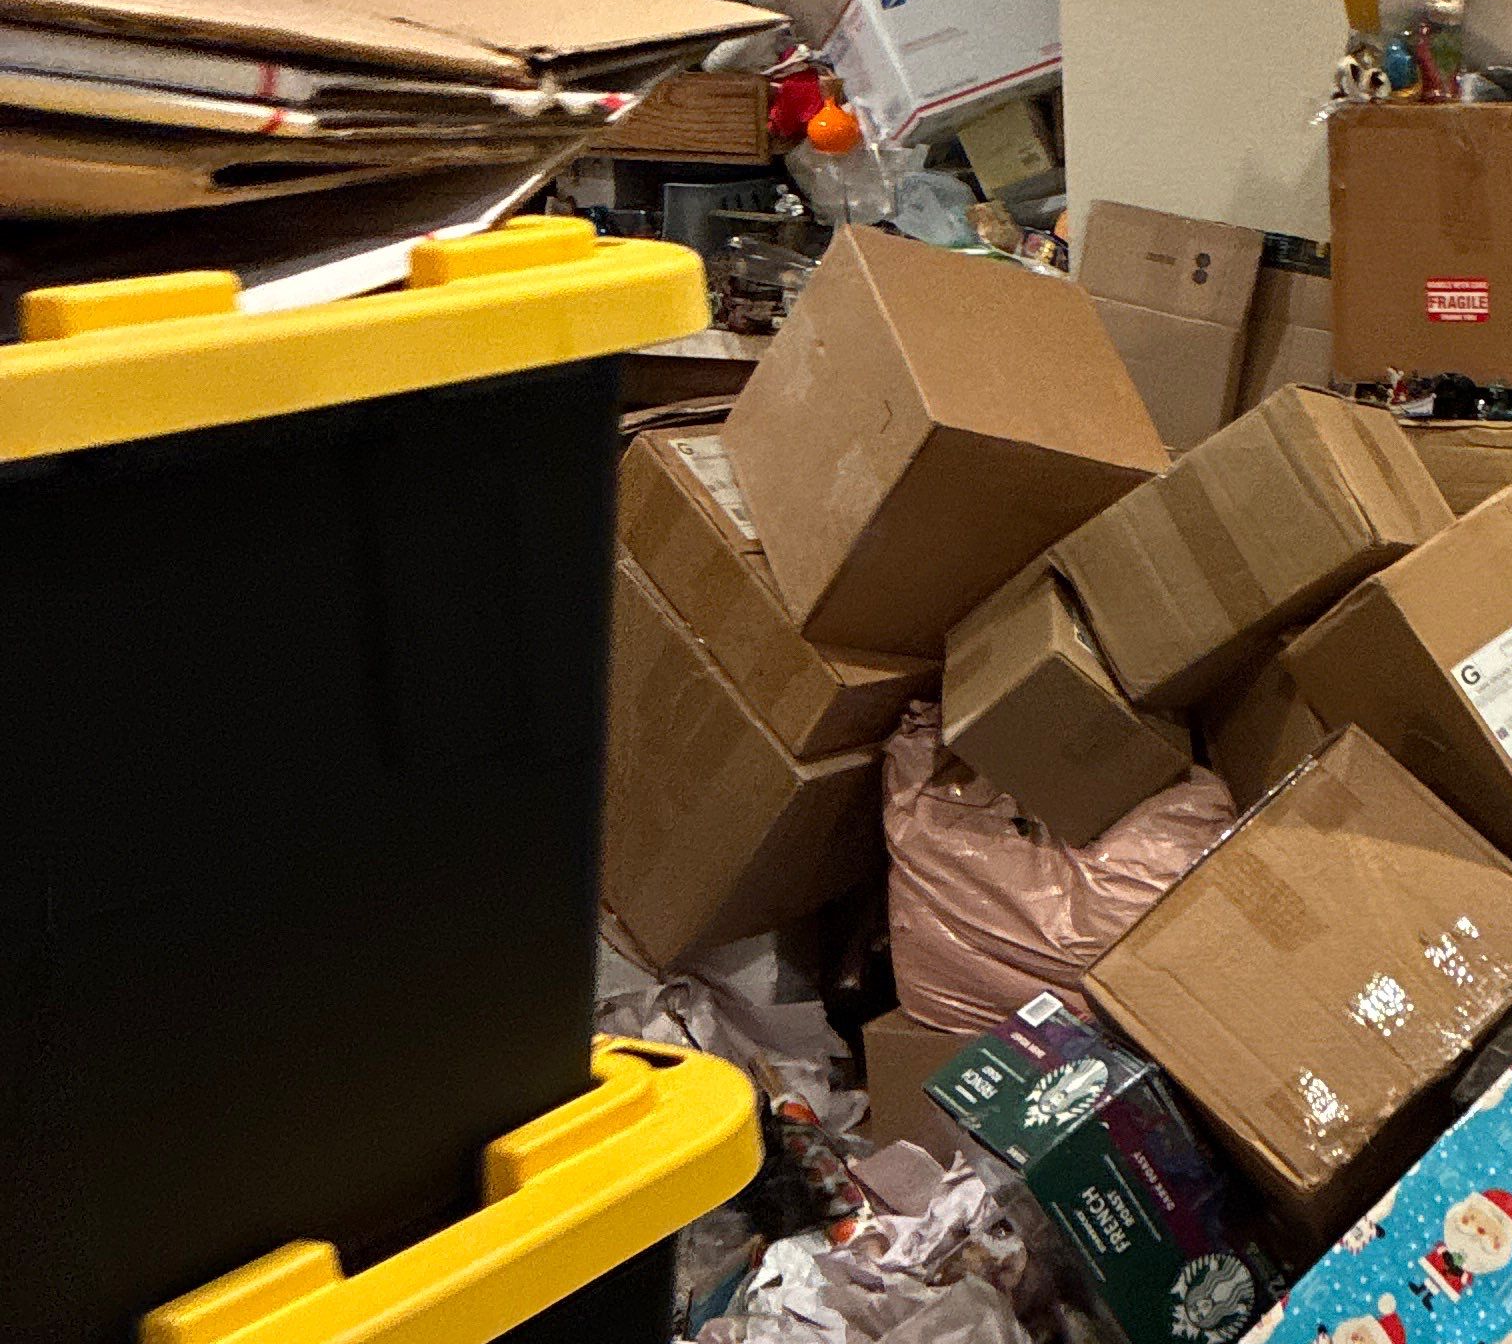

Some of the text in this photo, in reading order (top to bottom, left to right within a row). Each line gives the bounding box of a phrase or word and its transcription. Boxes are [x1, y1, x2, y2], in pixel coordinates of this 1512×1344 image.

[1426, 295, 1489, 309] FRAGILE
[1460, 663, 1482, 686] G
[1082, 1185, 1132, 1254] FRENCH
